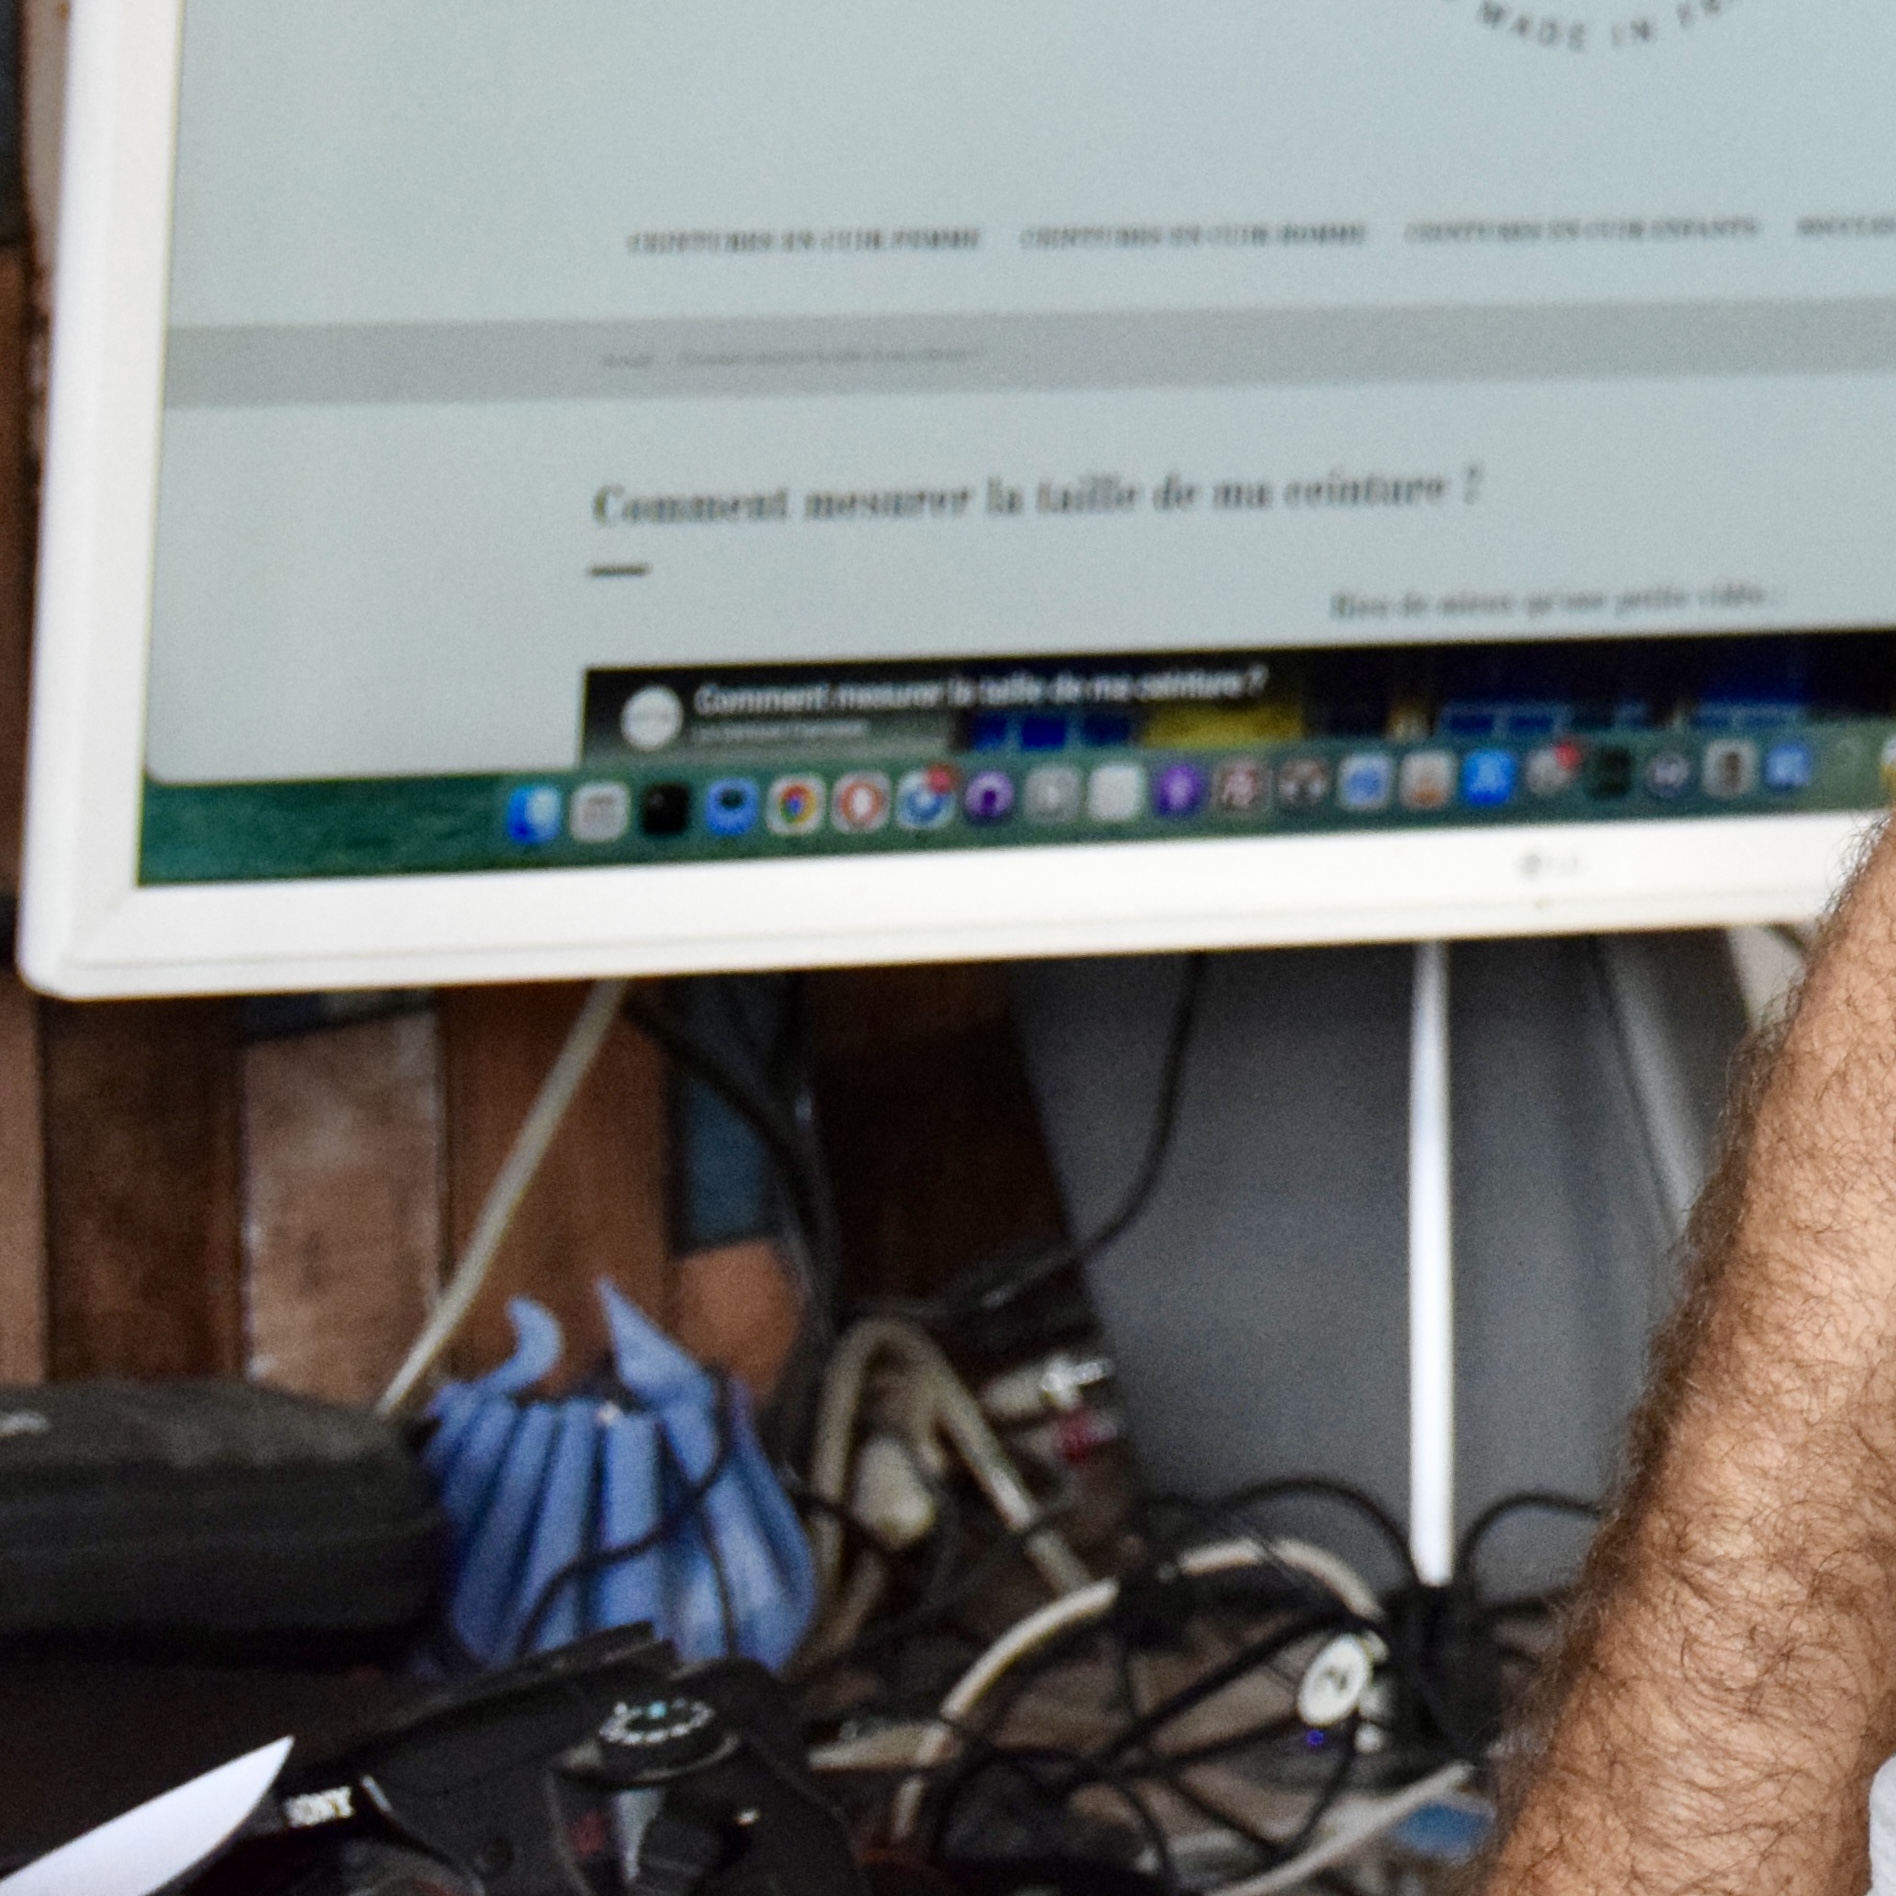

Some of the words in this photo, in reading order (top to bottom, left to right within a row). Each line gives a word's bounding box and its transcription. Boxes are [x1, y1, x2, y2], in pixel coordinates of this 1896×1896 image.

[1610, 19, 1655, 47] IN
[985, 476, 1026, 518] la
[1152, 473, 1200, 514] de
